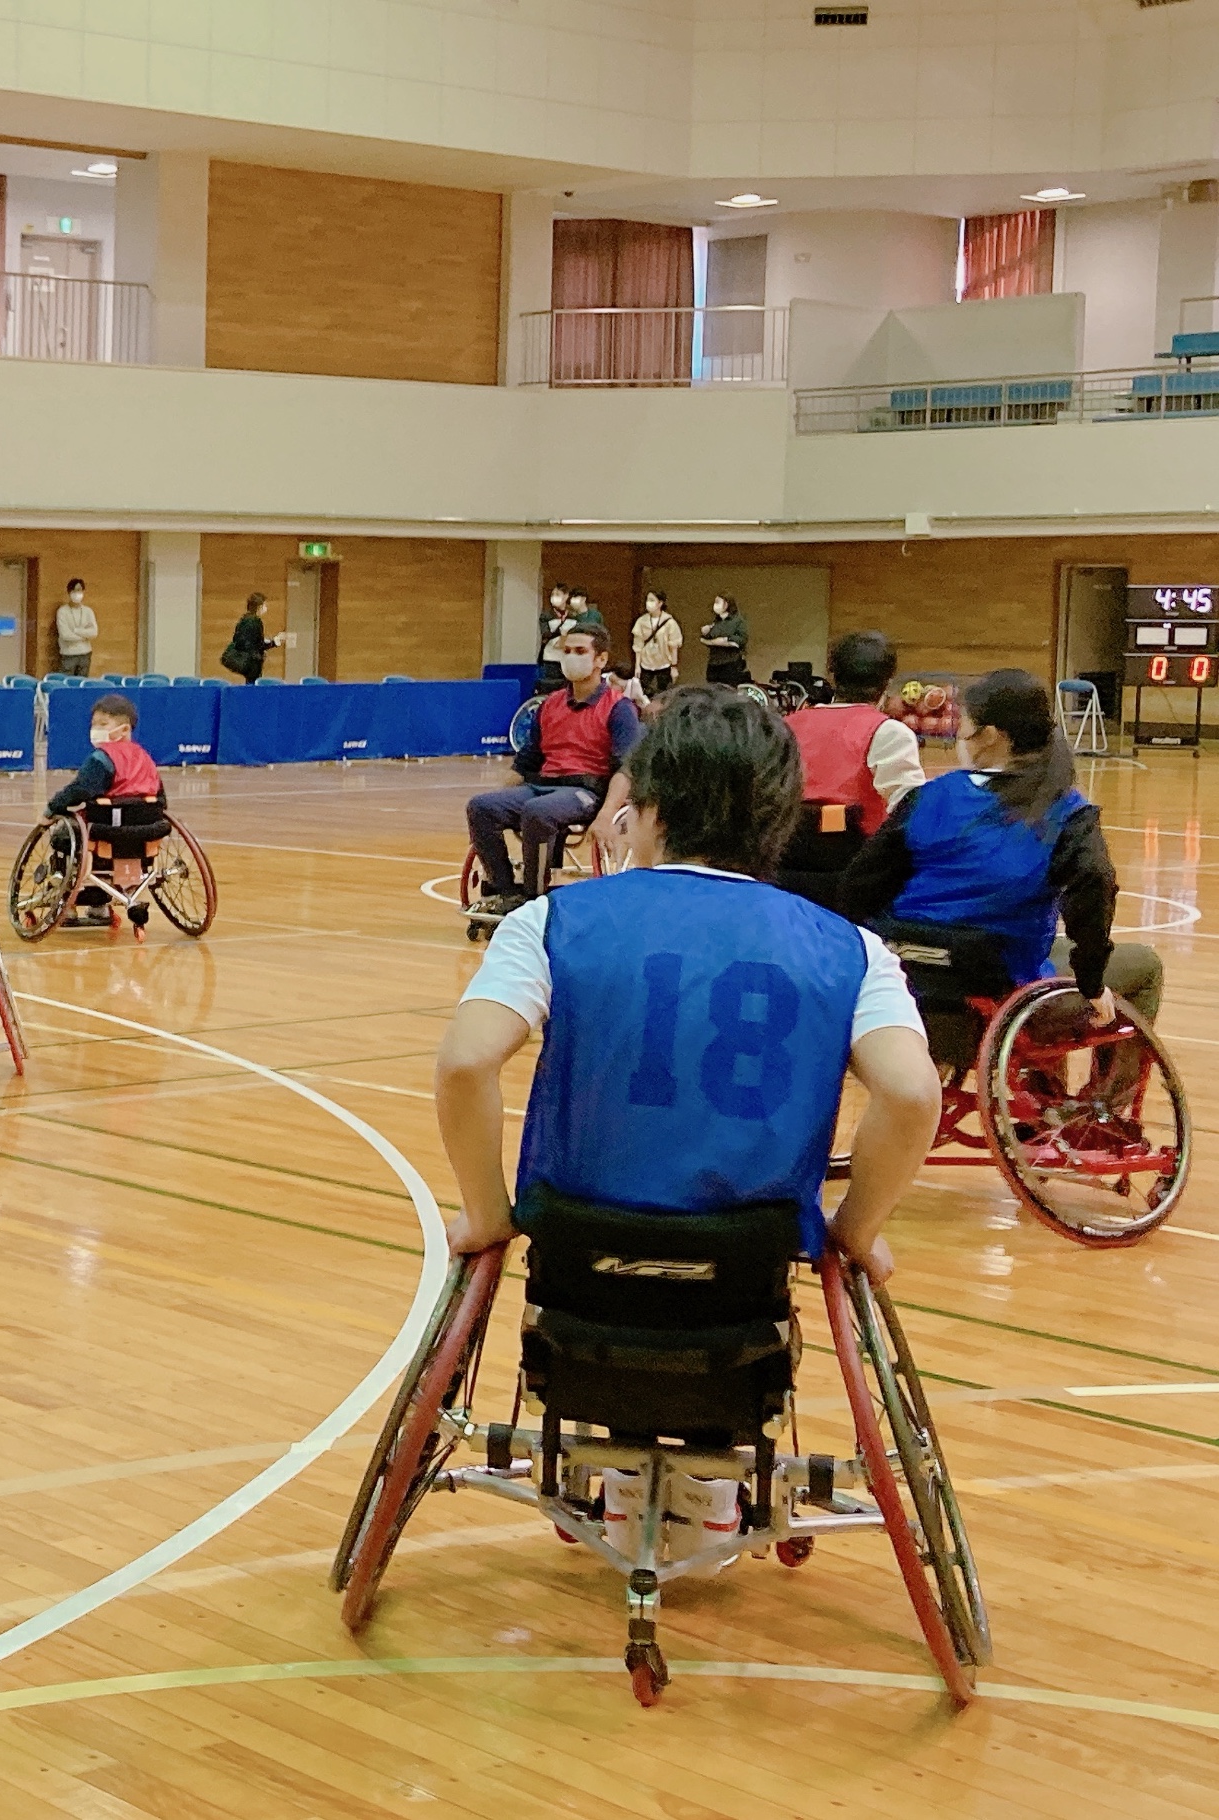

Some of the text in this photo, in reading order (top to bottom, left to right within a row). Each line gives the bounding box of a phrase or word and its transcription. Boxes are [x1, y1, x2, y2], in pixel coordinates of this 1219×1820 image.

[1155, 587, 1212, 613] 4:45
[1150, 655, 1211, 683] 0 0
[629, 952, 800, 1121] 18
